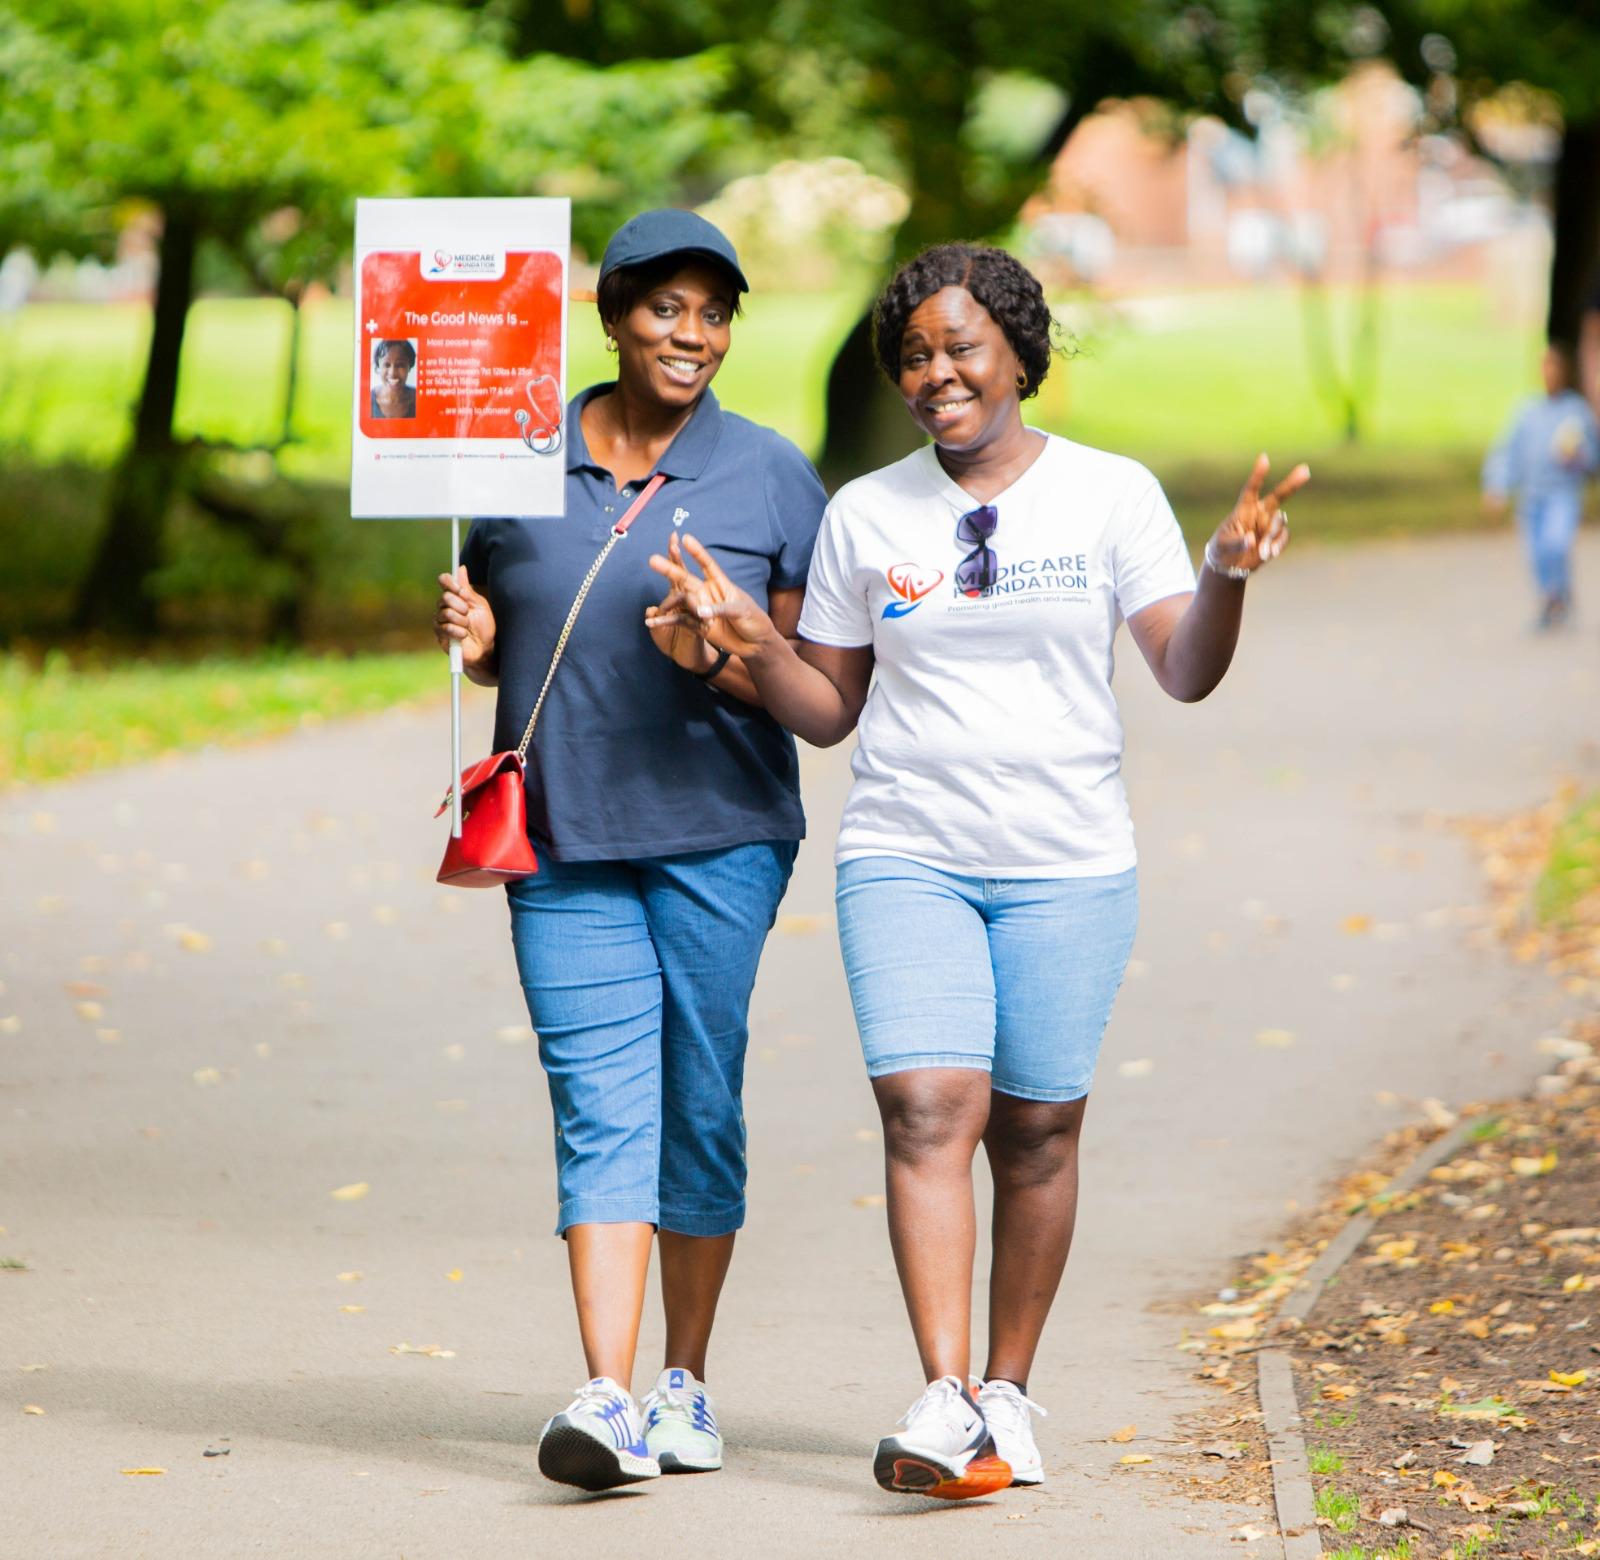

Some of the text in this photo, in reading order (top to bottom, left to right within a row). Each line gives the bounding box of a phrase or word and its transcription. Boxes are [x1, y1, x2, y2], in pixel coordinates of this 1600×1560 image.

[454, 254, 495, 262] MEDICARE
[405, 312, 427, 325] The
[431, 312, 465, 325] Good
[469, 312, 503, 325] News
[507, 312, 517, 325] Is
[426, 338, 444, 347] Most
[446, 338, 470, 349] people
[438, 358, 446, 366] fit
[454, 358, 480, 368] healthy
[426, 368, 448, 377] weigh
[448, 368, 480, 376] between
[434, 378, 452, 386] 50kg
[438, 387, 456, 396] aged
[457, 387, 488, 396] between
[947, 602, 990, 613] Promoting
[992, 600, 1013, 610] good
[1014, 596, 1042, 605] health
